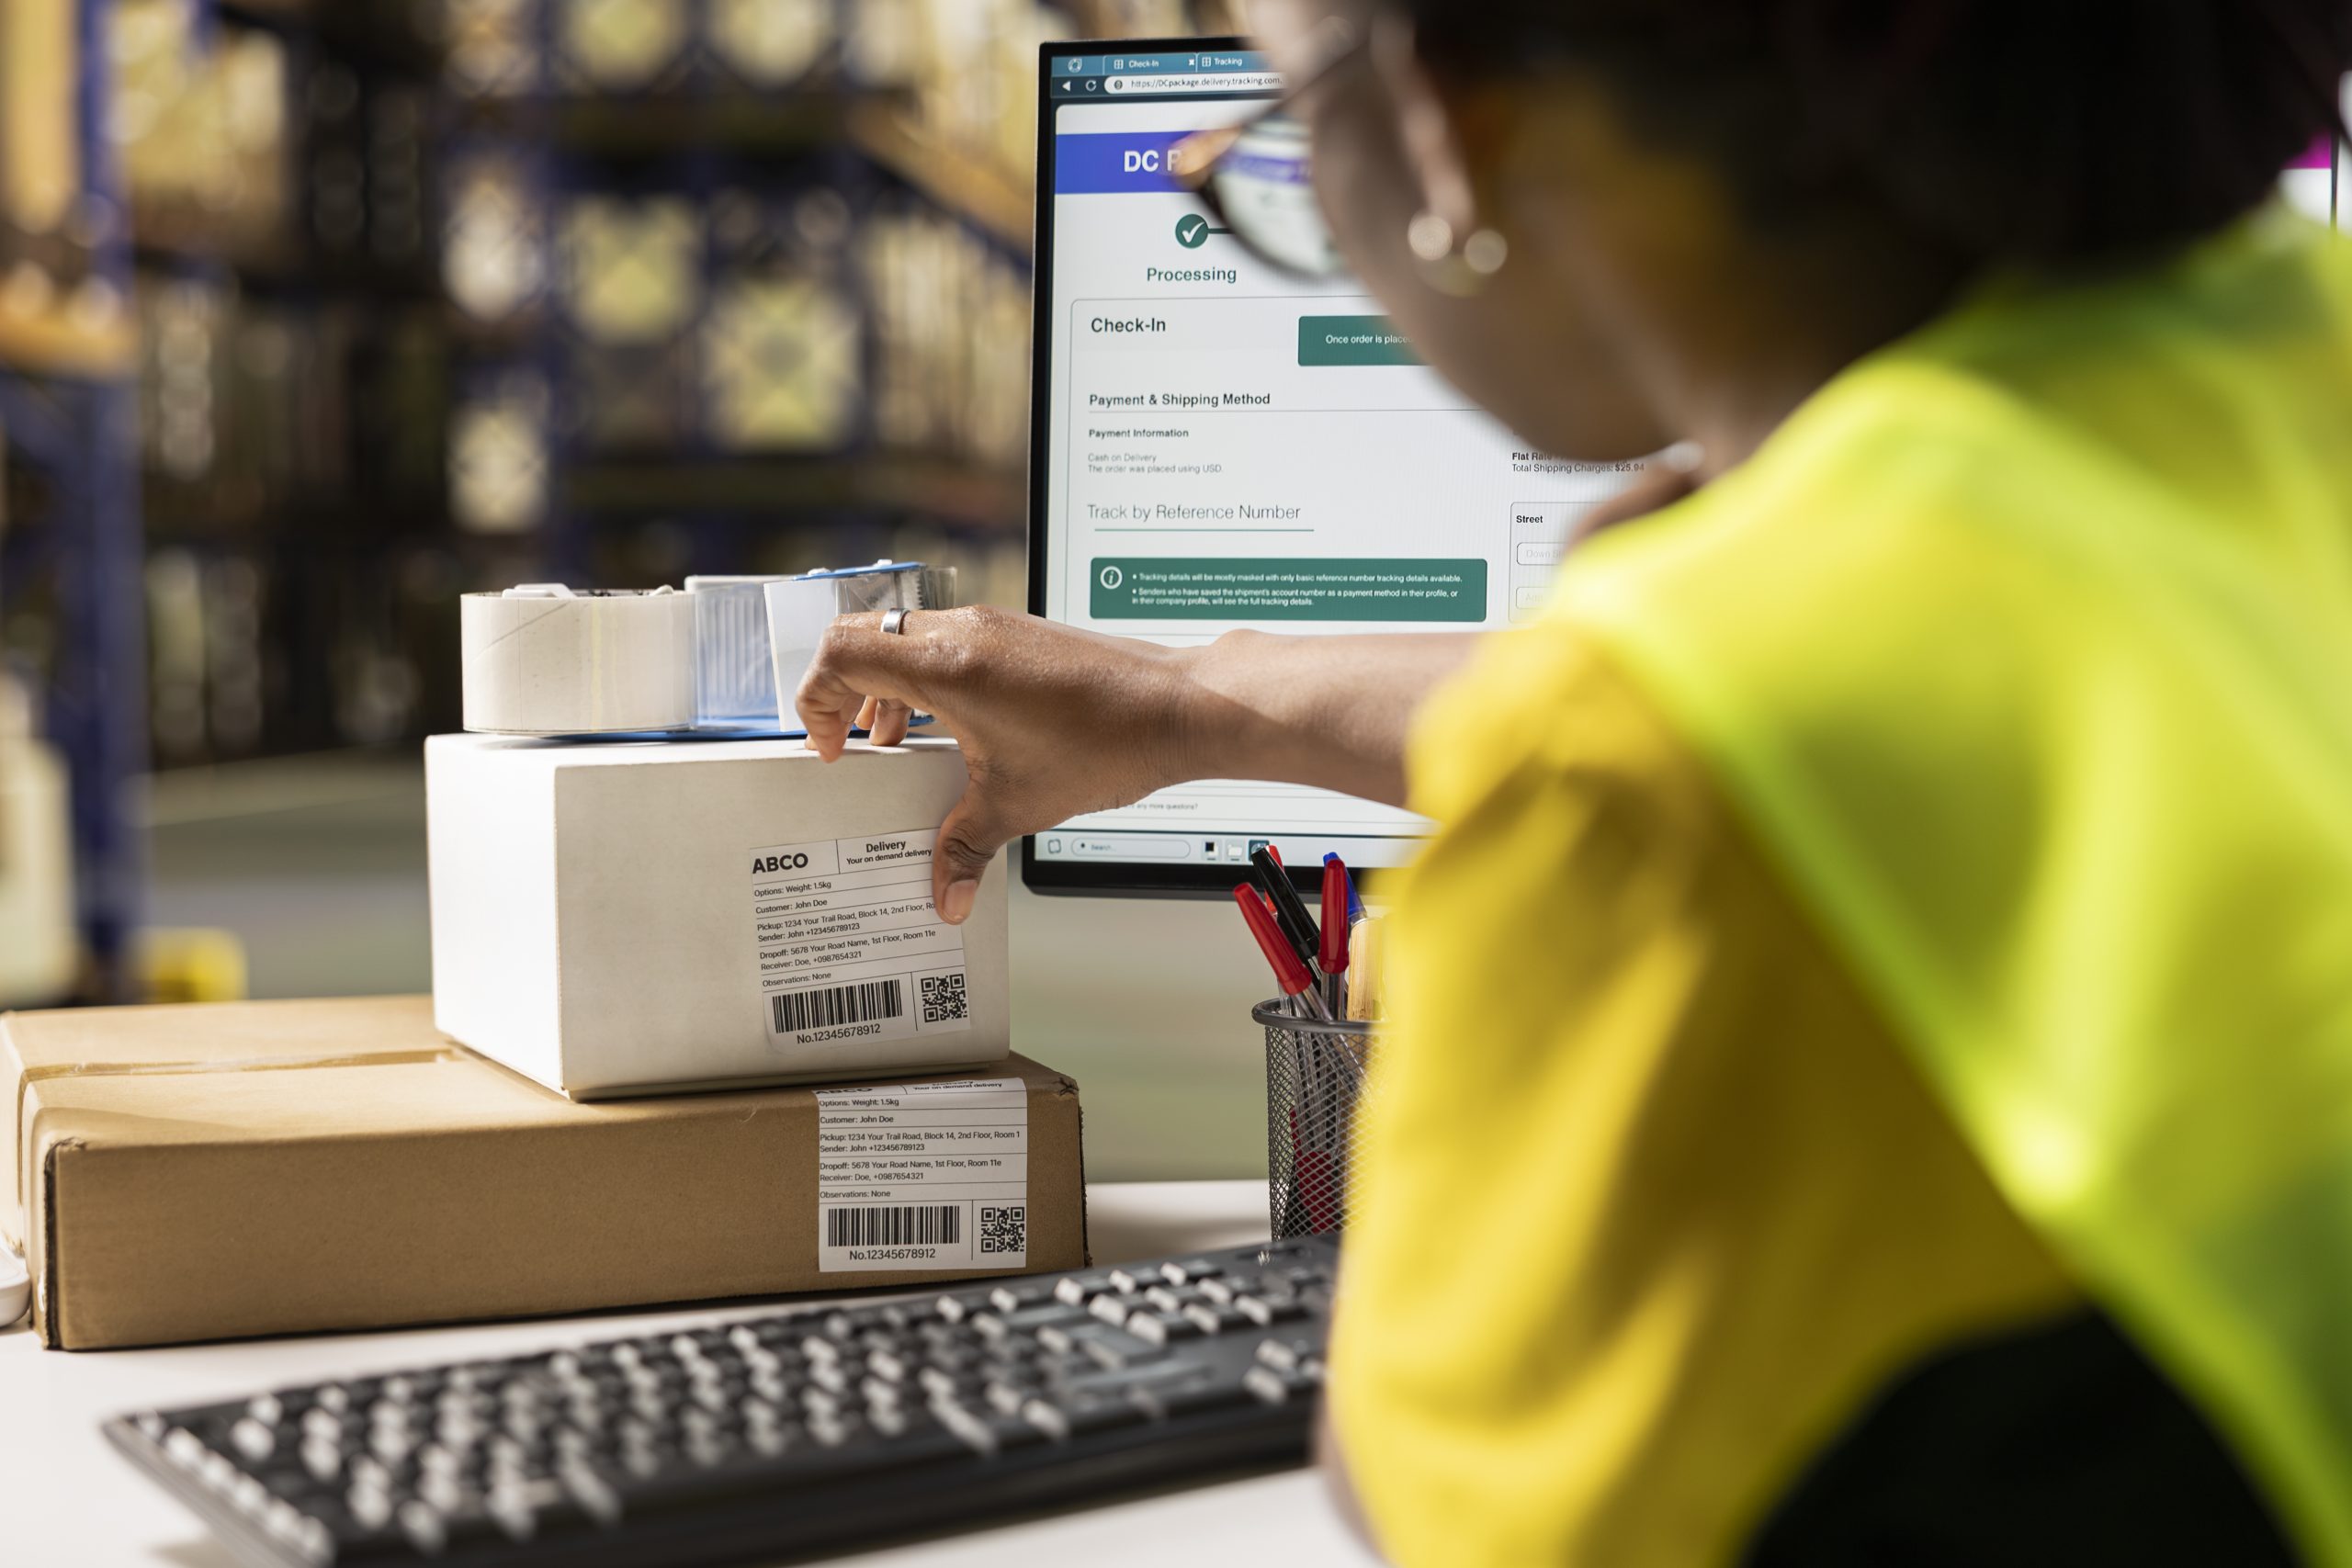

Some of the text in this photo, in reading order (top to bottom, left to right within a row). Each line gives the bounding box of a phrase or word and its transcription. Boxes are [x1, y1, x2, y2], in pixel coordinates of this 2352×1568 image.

[1128, 60, 1159, 68] Check-In
[1214, 57, 1243, 66] Tracking
[1124, 150, 1159, 173] DC
[1146, 266, 1238, 284] Processing
[1091, 317, 1167, 333] Check-In
[1325, 334, 1382, 344] Once order is
[1089, 392, 1271, 409] Payment & Shipping Method
[1088, 428, 1189, 439] Payment Information
[1088, 453, 1109, 462] Cash
[1124, 453, 1157, 463] Delivery
[1512, 452, 1530, 460] Flat
[1088, 465, 1102, 473] The
[1104, 465, 1126, 473] order
[1148, 465, 1176, 474] placed
[1178, 465, 1200, 475] using
[1512, 464, 1613, 474] Total Shipping Charges:
[1087, 504, 1301, 522] Track by Reference Number
[1516, 515, 1544, 524] Street
[1139, 573, 1167, 582] Tracking
[1169, 573, 1191, 581] details
[1192, 573, 1203, 581] will
[1215, 574, 1236, 582] mostly
[1281, 574, 1295, 582] only
[1316, 574, 1348, 582] reference
[1350, 574, 1375, 582] number
[1377, 574, 1405, 583] tracking
[1138, 588, 1167, 596] Senders
[1168, 588, 1182, 596] who
[1182, 588, 1200, 596] have
[1201, 588, 1221, 596] saved
[1222, 588, 1233, 596] the
[1235, 588, 1271, 597] shipment's
[1272, 589, 1299, 597] account
[1300, 589, 1326, 597] number
[1343, 590, 1373, 598] payment
[1426, 590, 1450, 598] profile,
[1156, 598, 1186, 606] company
[1261, 598, 1288, 607] tracking
[865, 840, 907, 853] Delivery
[846, 856, 863, 865] Your
[875, 852, 903, 862] demand
[904, 848, 933, 859] delivery
[752, 852, 808, 874] ABCO
[753, 881, 831, 897] Options: Weight: 1.5kg
[755, 898, 828, 914] Customer: John Doe
[757, 902, 925, 932] Pickup: 1234 Your Trail Road, Block 14, 2nd Floor,
[758, 922, 861, 942] Sender: John +123456789123
[760, 930, 936, 961] Dropoff: 5678 Your Road Name, 1st Floor, Room 11e
[761, 950, 862, 971] Receiver: Doe, +0987654321
[763, 971, 831, 987] Observations: None
[797, 1023, 881, 1044] No.12345678912
[819, 1098, 899, 1108] Options: Weight: 1.5kg
[859, 1115, 877, 1123] John
[820, 1133, 847, 1142] Pickup:
[848, 1133, 865, 1141] 1234
[867, 1132, 884, 1140] Your
[886, 1132, 901, 1140] Trail
[902, 1132, 922, 1141] Road,
[924, 1131, 944, 1140] Block
[945, 1132, 956, 1140] 14,
[957, 1131, 972, 1139] 2nd
[973, 1131, 993, 1140] Floor,
[820, 1144, 925, 1153] Sender: John +123456789123
[820, 1161, 850, 1171] Dropoff:
[851, 1161, 870, 1169] 5678
[872, 1161, 888, 1169] Your
[889, 1160, 909, 1168] Road
[910, 1160, 933, 1169] Name,
[946, 1159, 967, 1168] Floor,
[967, 1159, 989, 1168] Room
[820, 1172, 923, 1181] Receiver: Doe, +0987654321
[820, 1190, 891, 1199] Observations: None
[849, 1248, 936, 1260] No.12345678912
